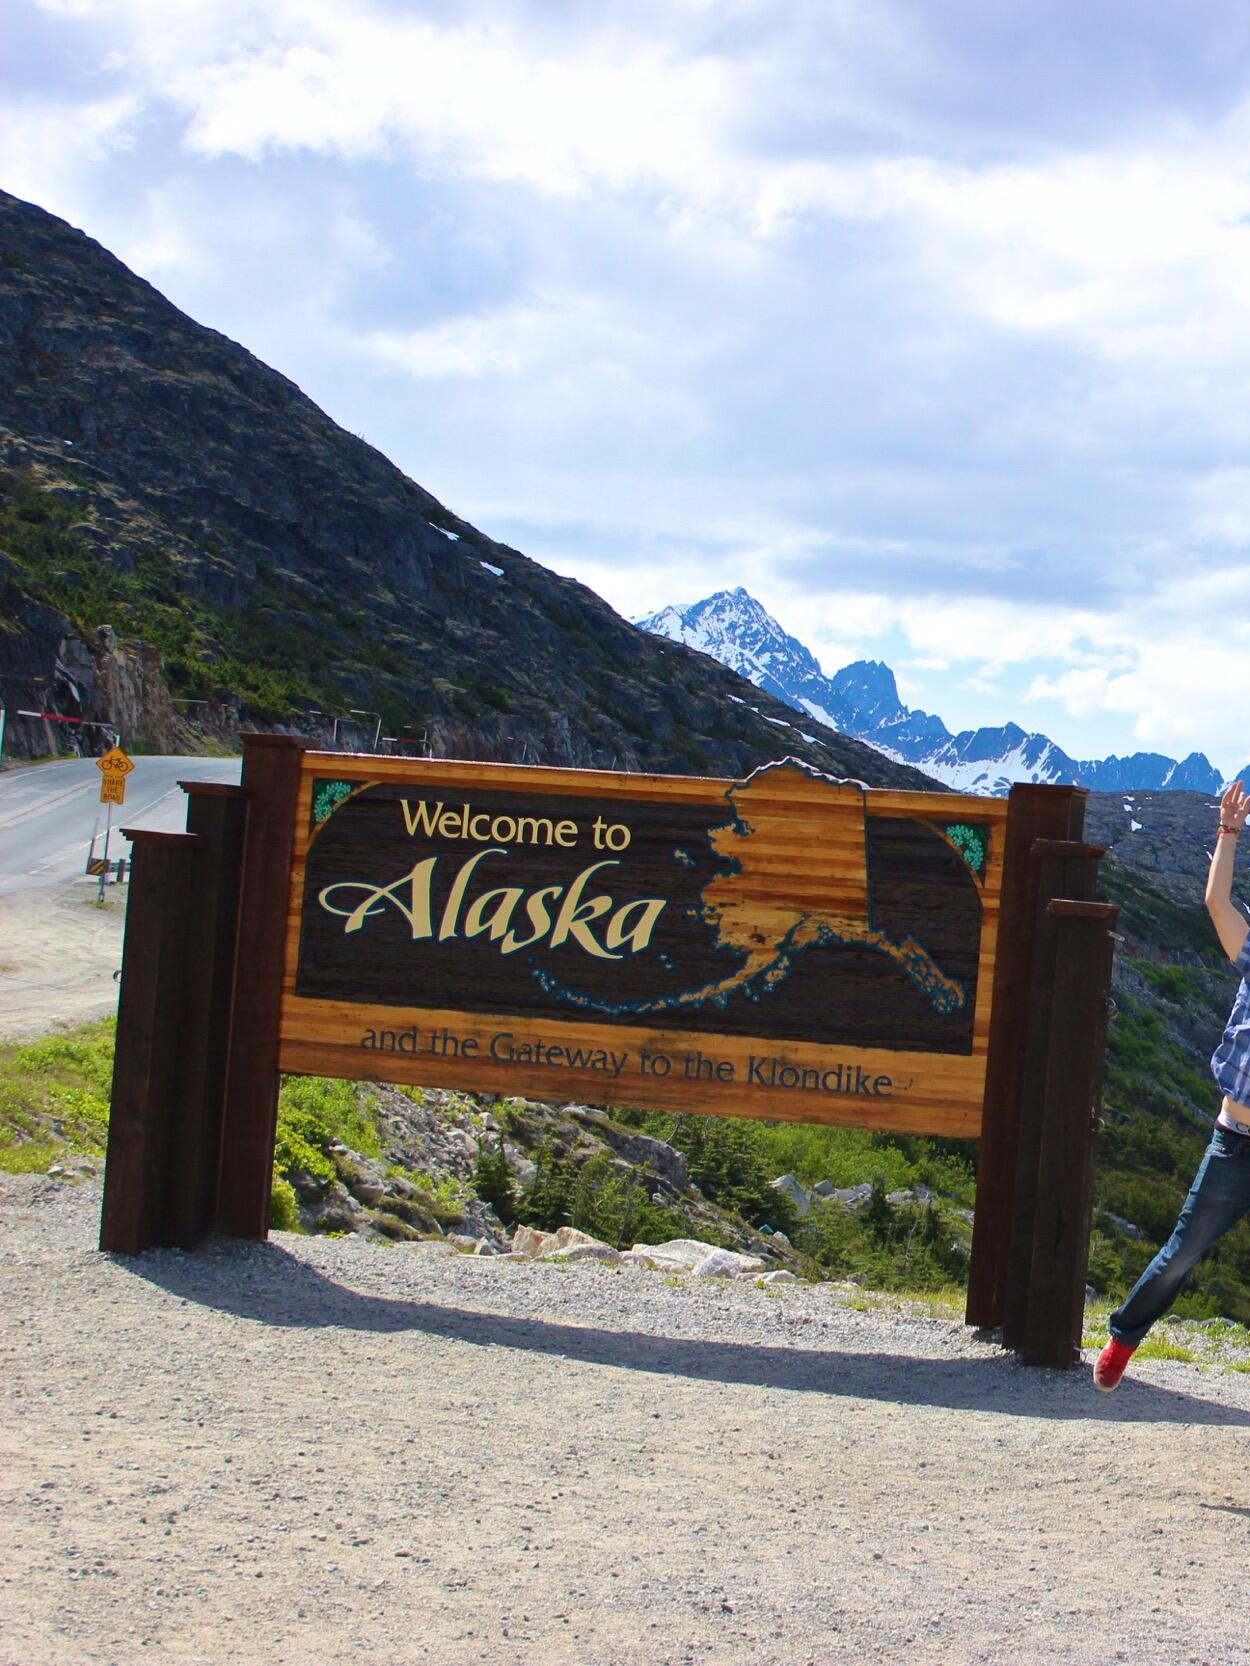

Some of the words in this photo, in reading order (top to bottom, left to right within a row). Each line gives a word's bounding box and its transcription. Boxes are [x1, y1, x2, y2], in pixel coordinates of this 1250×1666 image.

[400, 799, 578, 847] Welcome
[592, 816, 631, 850] to
[318, 849, 666, 959] Alaska
[360, 1025, 418, 1054] and
[430, 1027, 479, 1059] the
[489, 1032, 628, 1078] Gateway
[638, 1050, 672, 1076] to
[684, 1052, 735, 1082] the
[747, 1056, 893, 1096] Klondike
